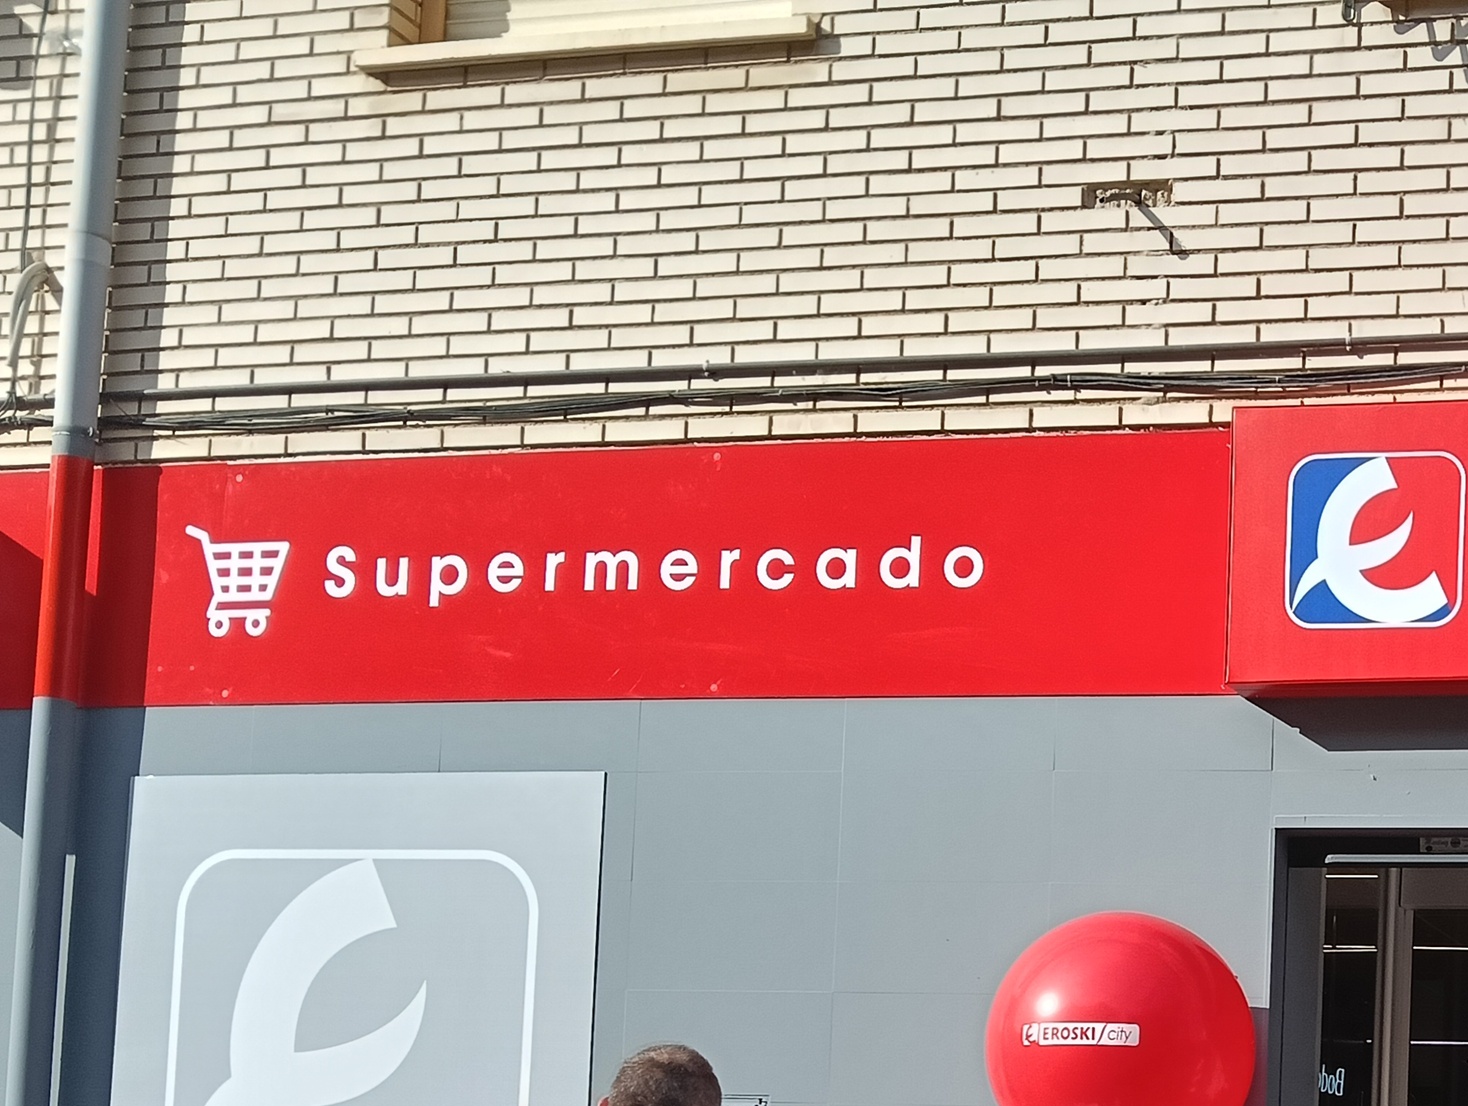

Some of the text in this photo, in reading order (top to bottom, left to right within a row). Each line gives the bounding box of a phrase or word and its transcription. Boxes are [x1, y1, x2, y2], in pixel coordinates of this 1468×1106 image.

[323, 535, 984, 607] Supermercado
[1043, 1026, 1132, 1043] EROSKI city
